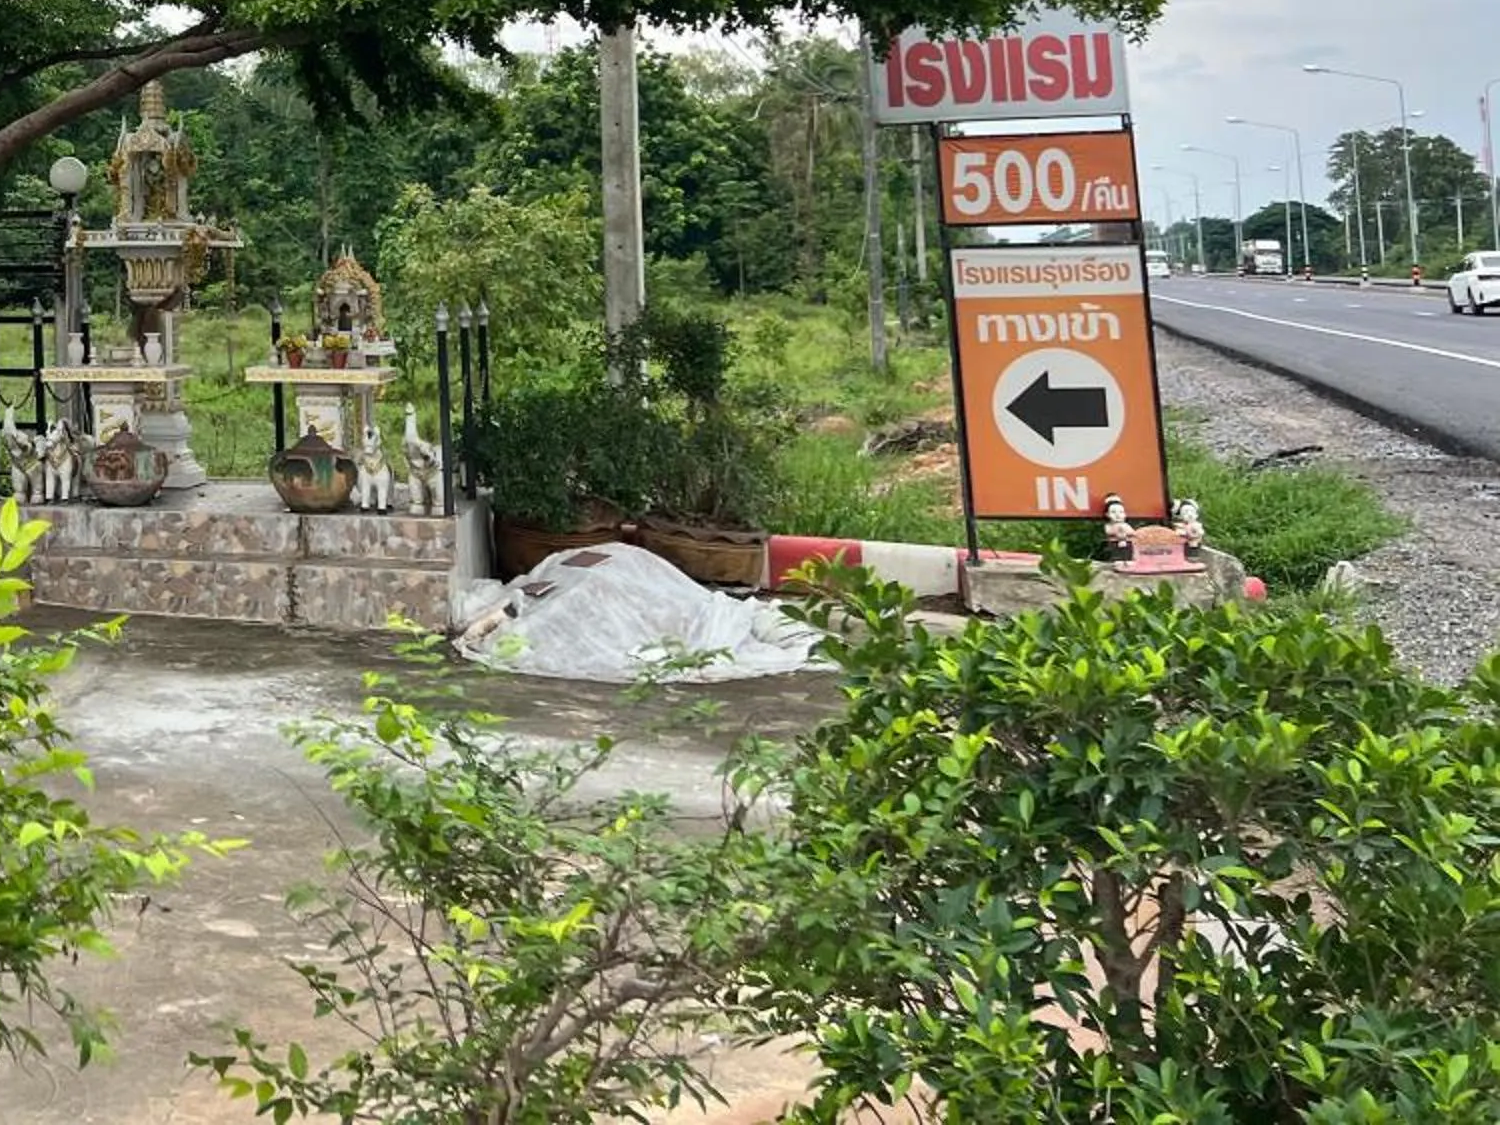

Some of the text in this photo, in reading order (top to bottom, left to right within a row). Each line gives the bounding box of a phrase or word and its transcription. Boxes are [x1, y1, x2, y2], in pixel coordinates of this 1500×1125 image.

[956, 255, 1131, 289] โรงแรมรุ่งเรือง
[976, 302, 1122, 343] ทางเข้า
[1035, 476, 1090, 511] IN
